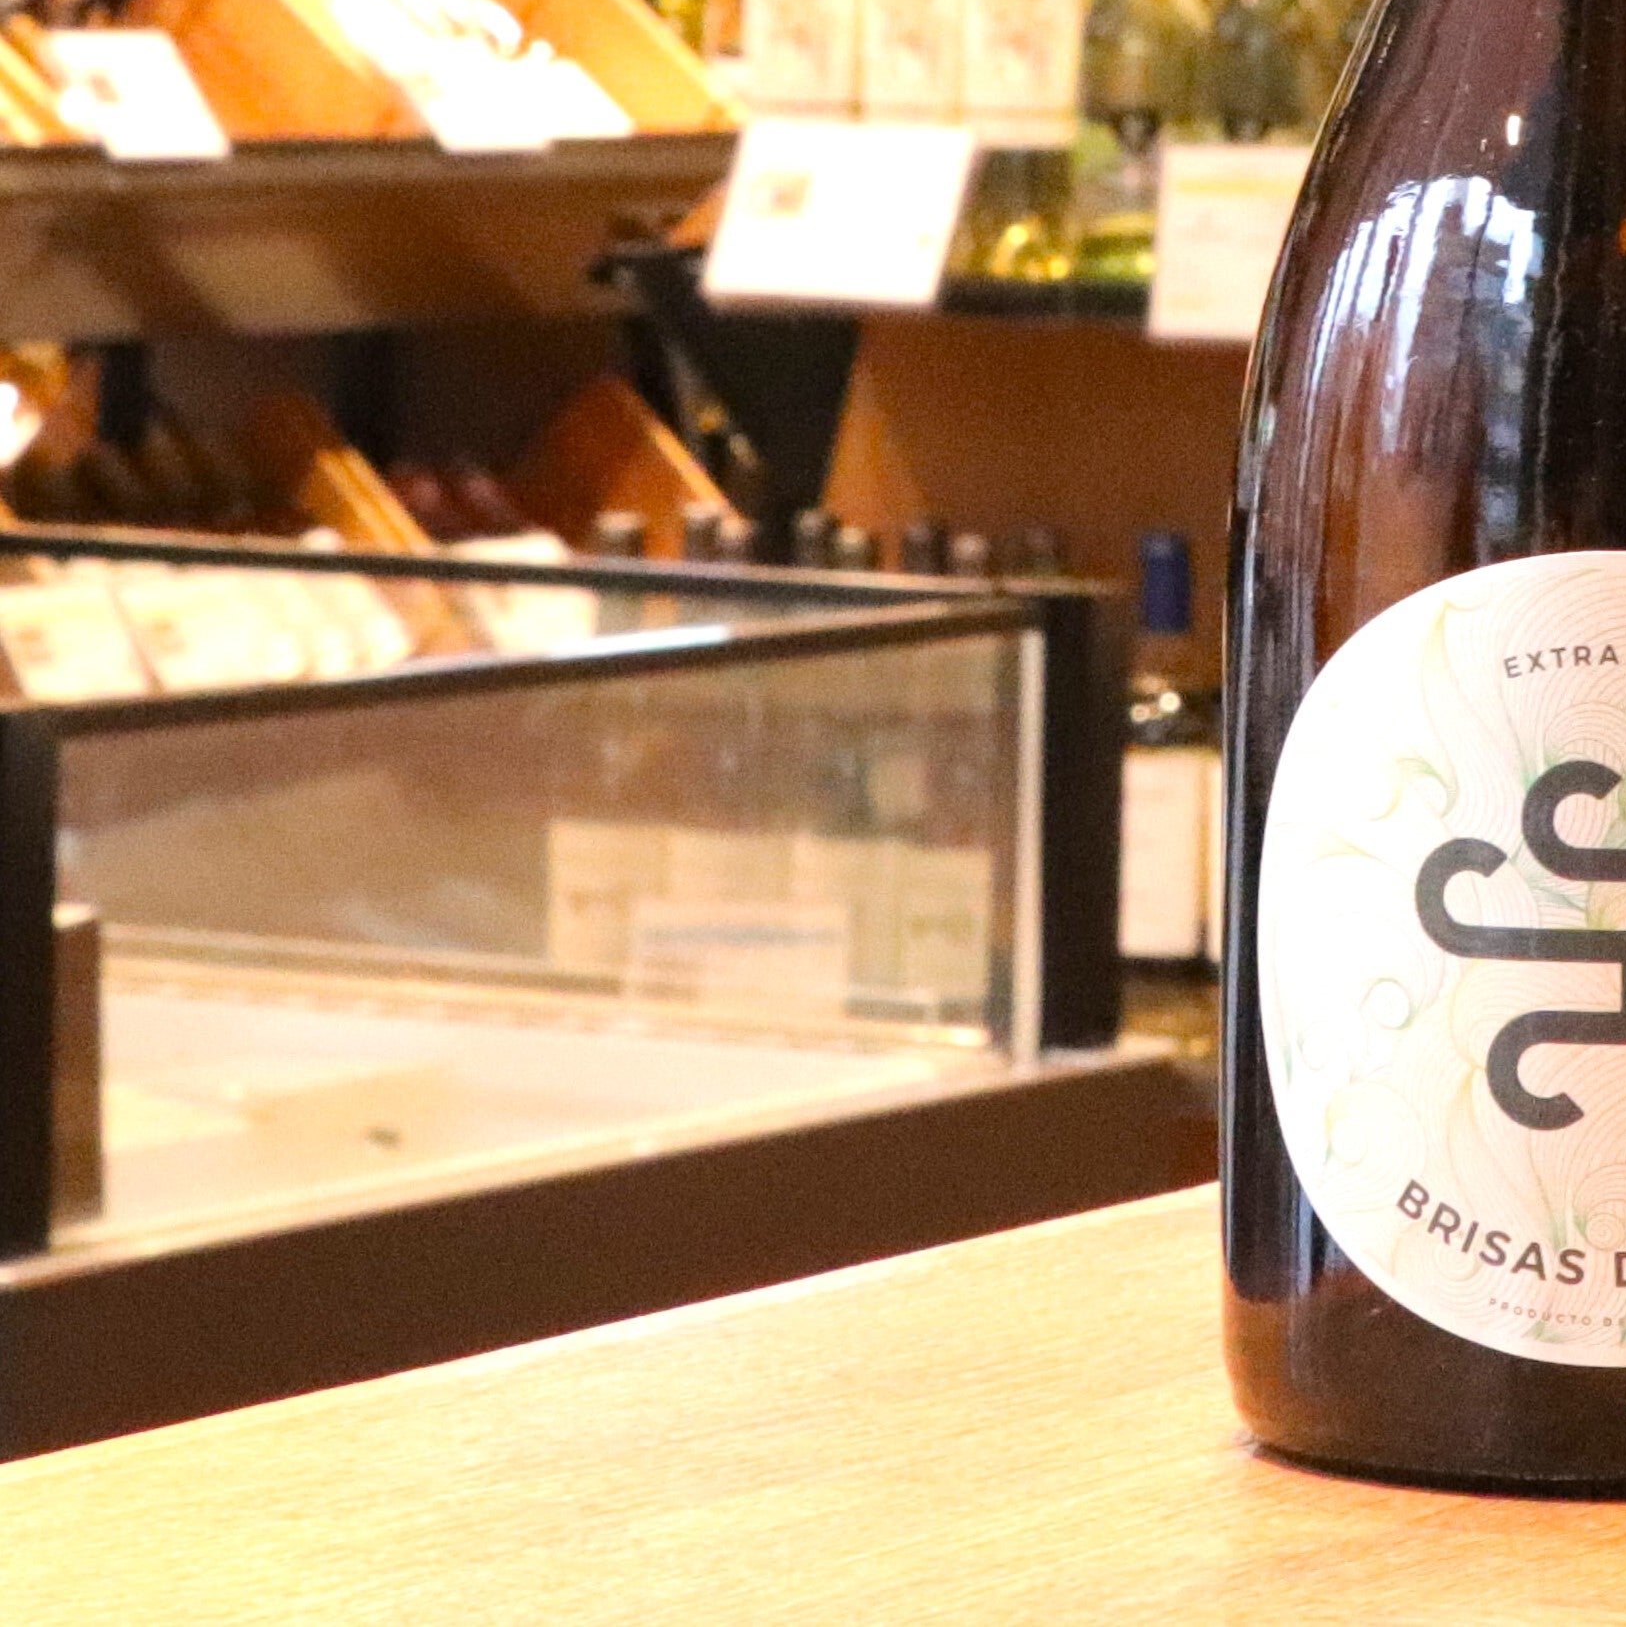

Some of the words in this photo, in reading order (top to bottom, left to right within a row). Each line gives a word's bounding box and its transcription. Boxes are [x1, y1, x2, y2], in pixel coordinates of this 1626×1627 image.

[1503, 644, 1619, 678] EXTRA
[1396, 1179, 1587, 1285] BRISAS
[1489, 1297, 1592, 1326] PRODUCTO
[1602, 1316, 1626, 1327] DE
